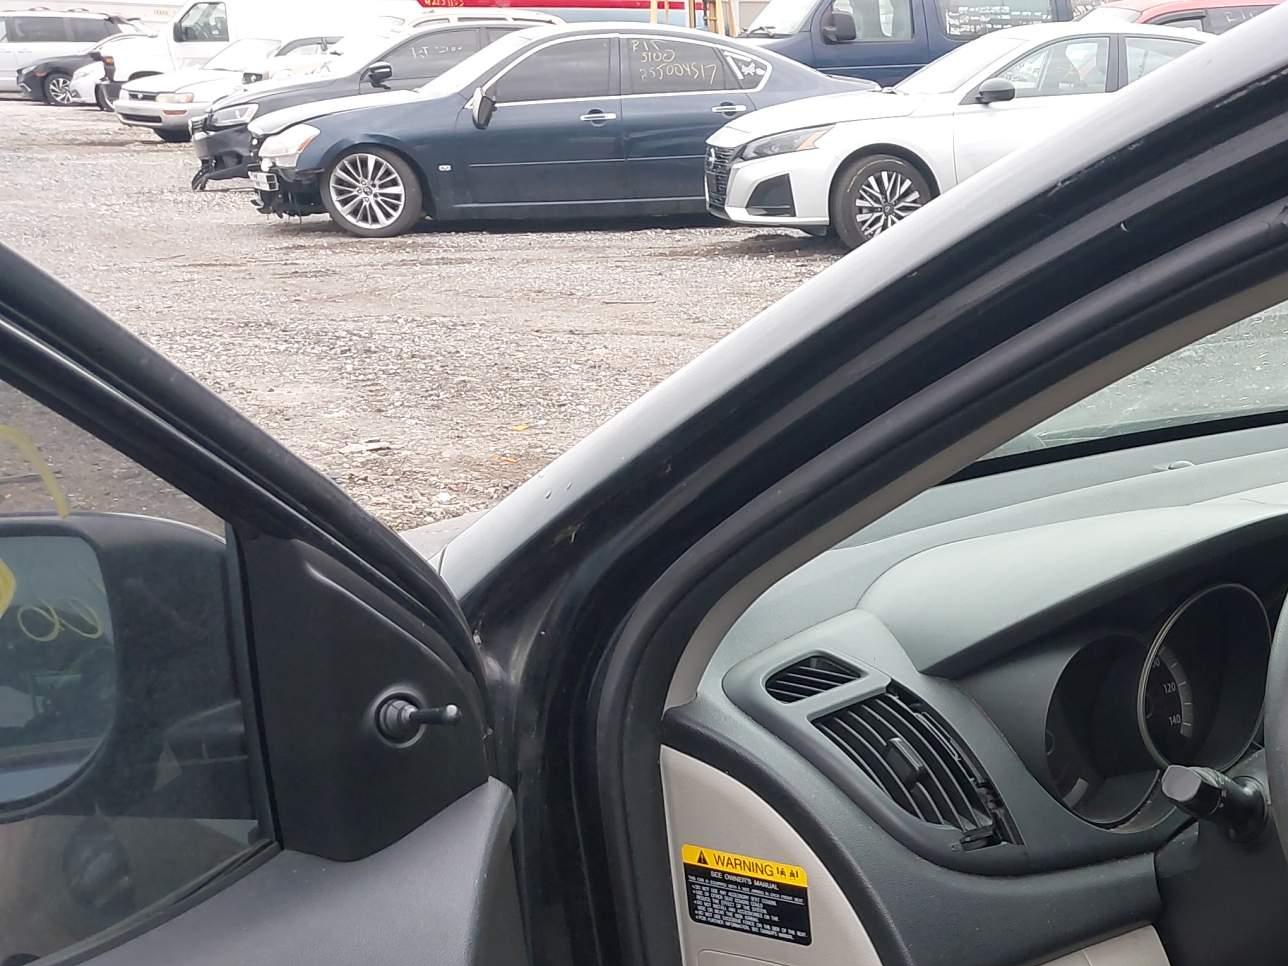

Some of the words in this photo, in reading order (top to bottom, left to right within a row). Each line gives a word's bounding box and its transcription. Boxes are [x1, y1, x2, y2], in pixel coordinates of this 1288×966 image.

[1163, 682, 1177, 694] 120
[1168, 713, 1182, 726] 140
[713, 853, 774, 876] WARNING
